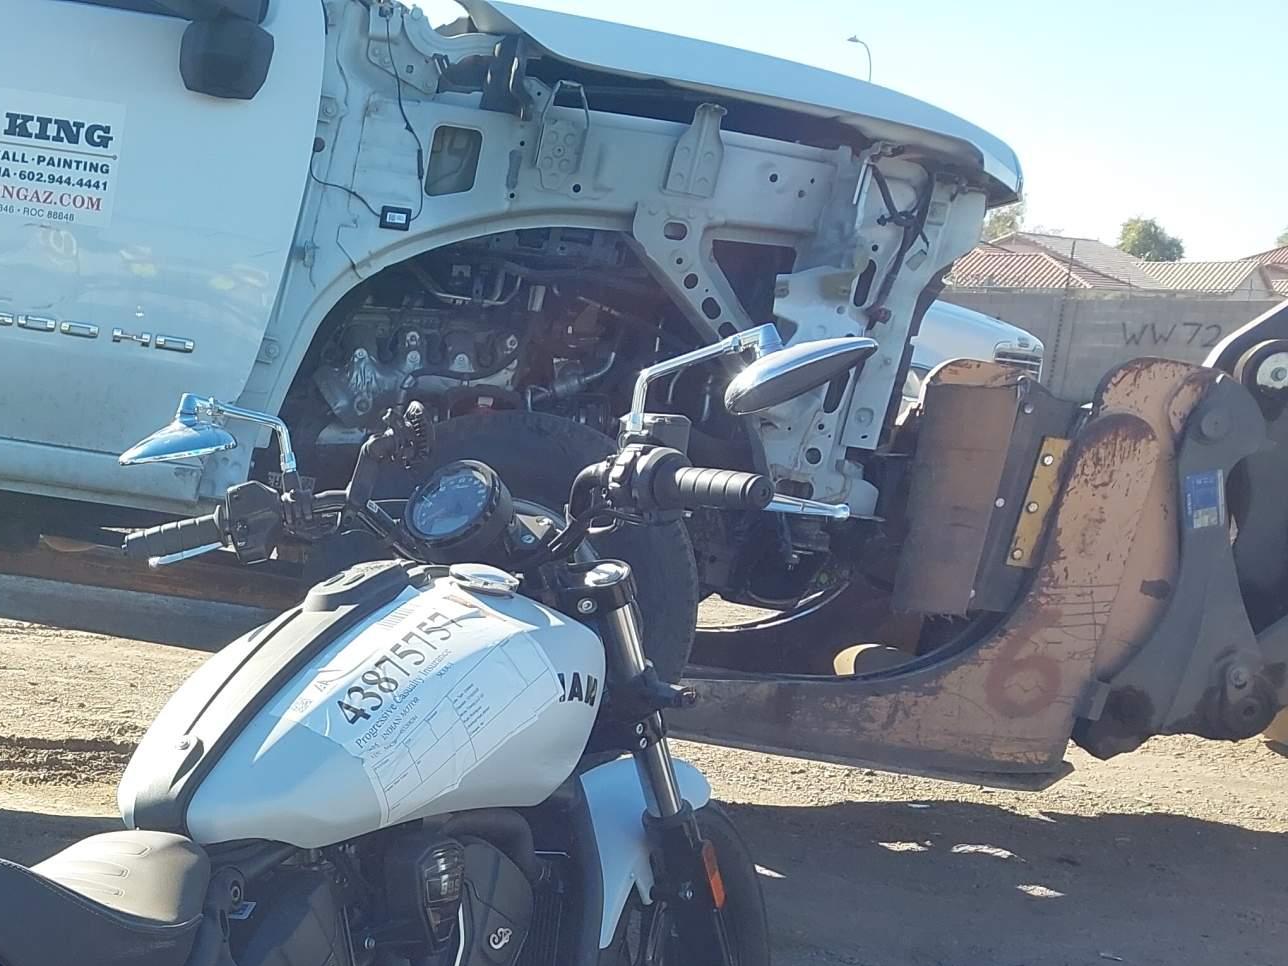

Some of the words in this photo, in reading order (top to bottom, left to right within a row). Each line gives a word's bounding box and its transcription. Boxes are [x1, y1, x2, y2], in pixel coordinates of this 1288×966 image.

[3, 112, 114, 149] KING
[23, 206, 45, 218] ROC
[112, 328, 196, 354] HD
[337, 611, 463, 725] 43875757
[355, 702, 398, 749] Progressive
[393, 678, 425, 704] Casualty
[419, 649, 452, 677] Insurance
